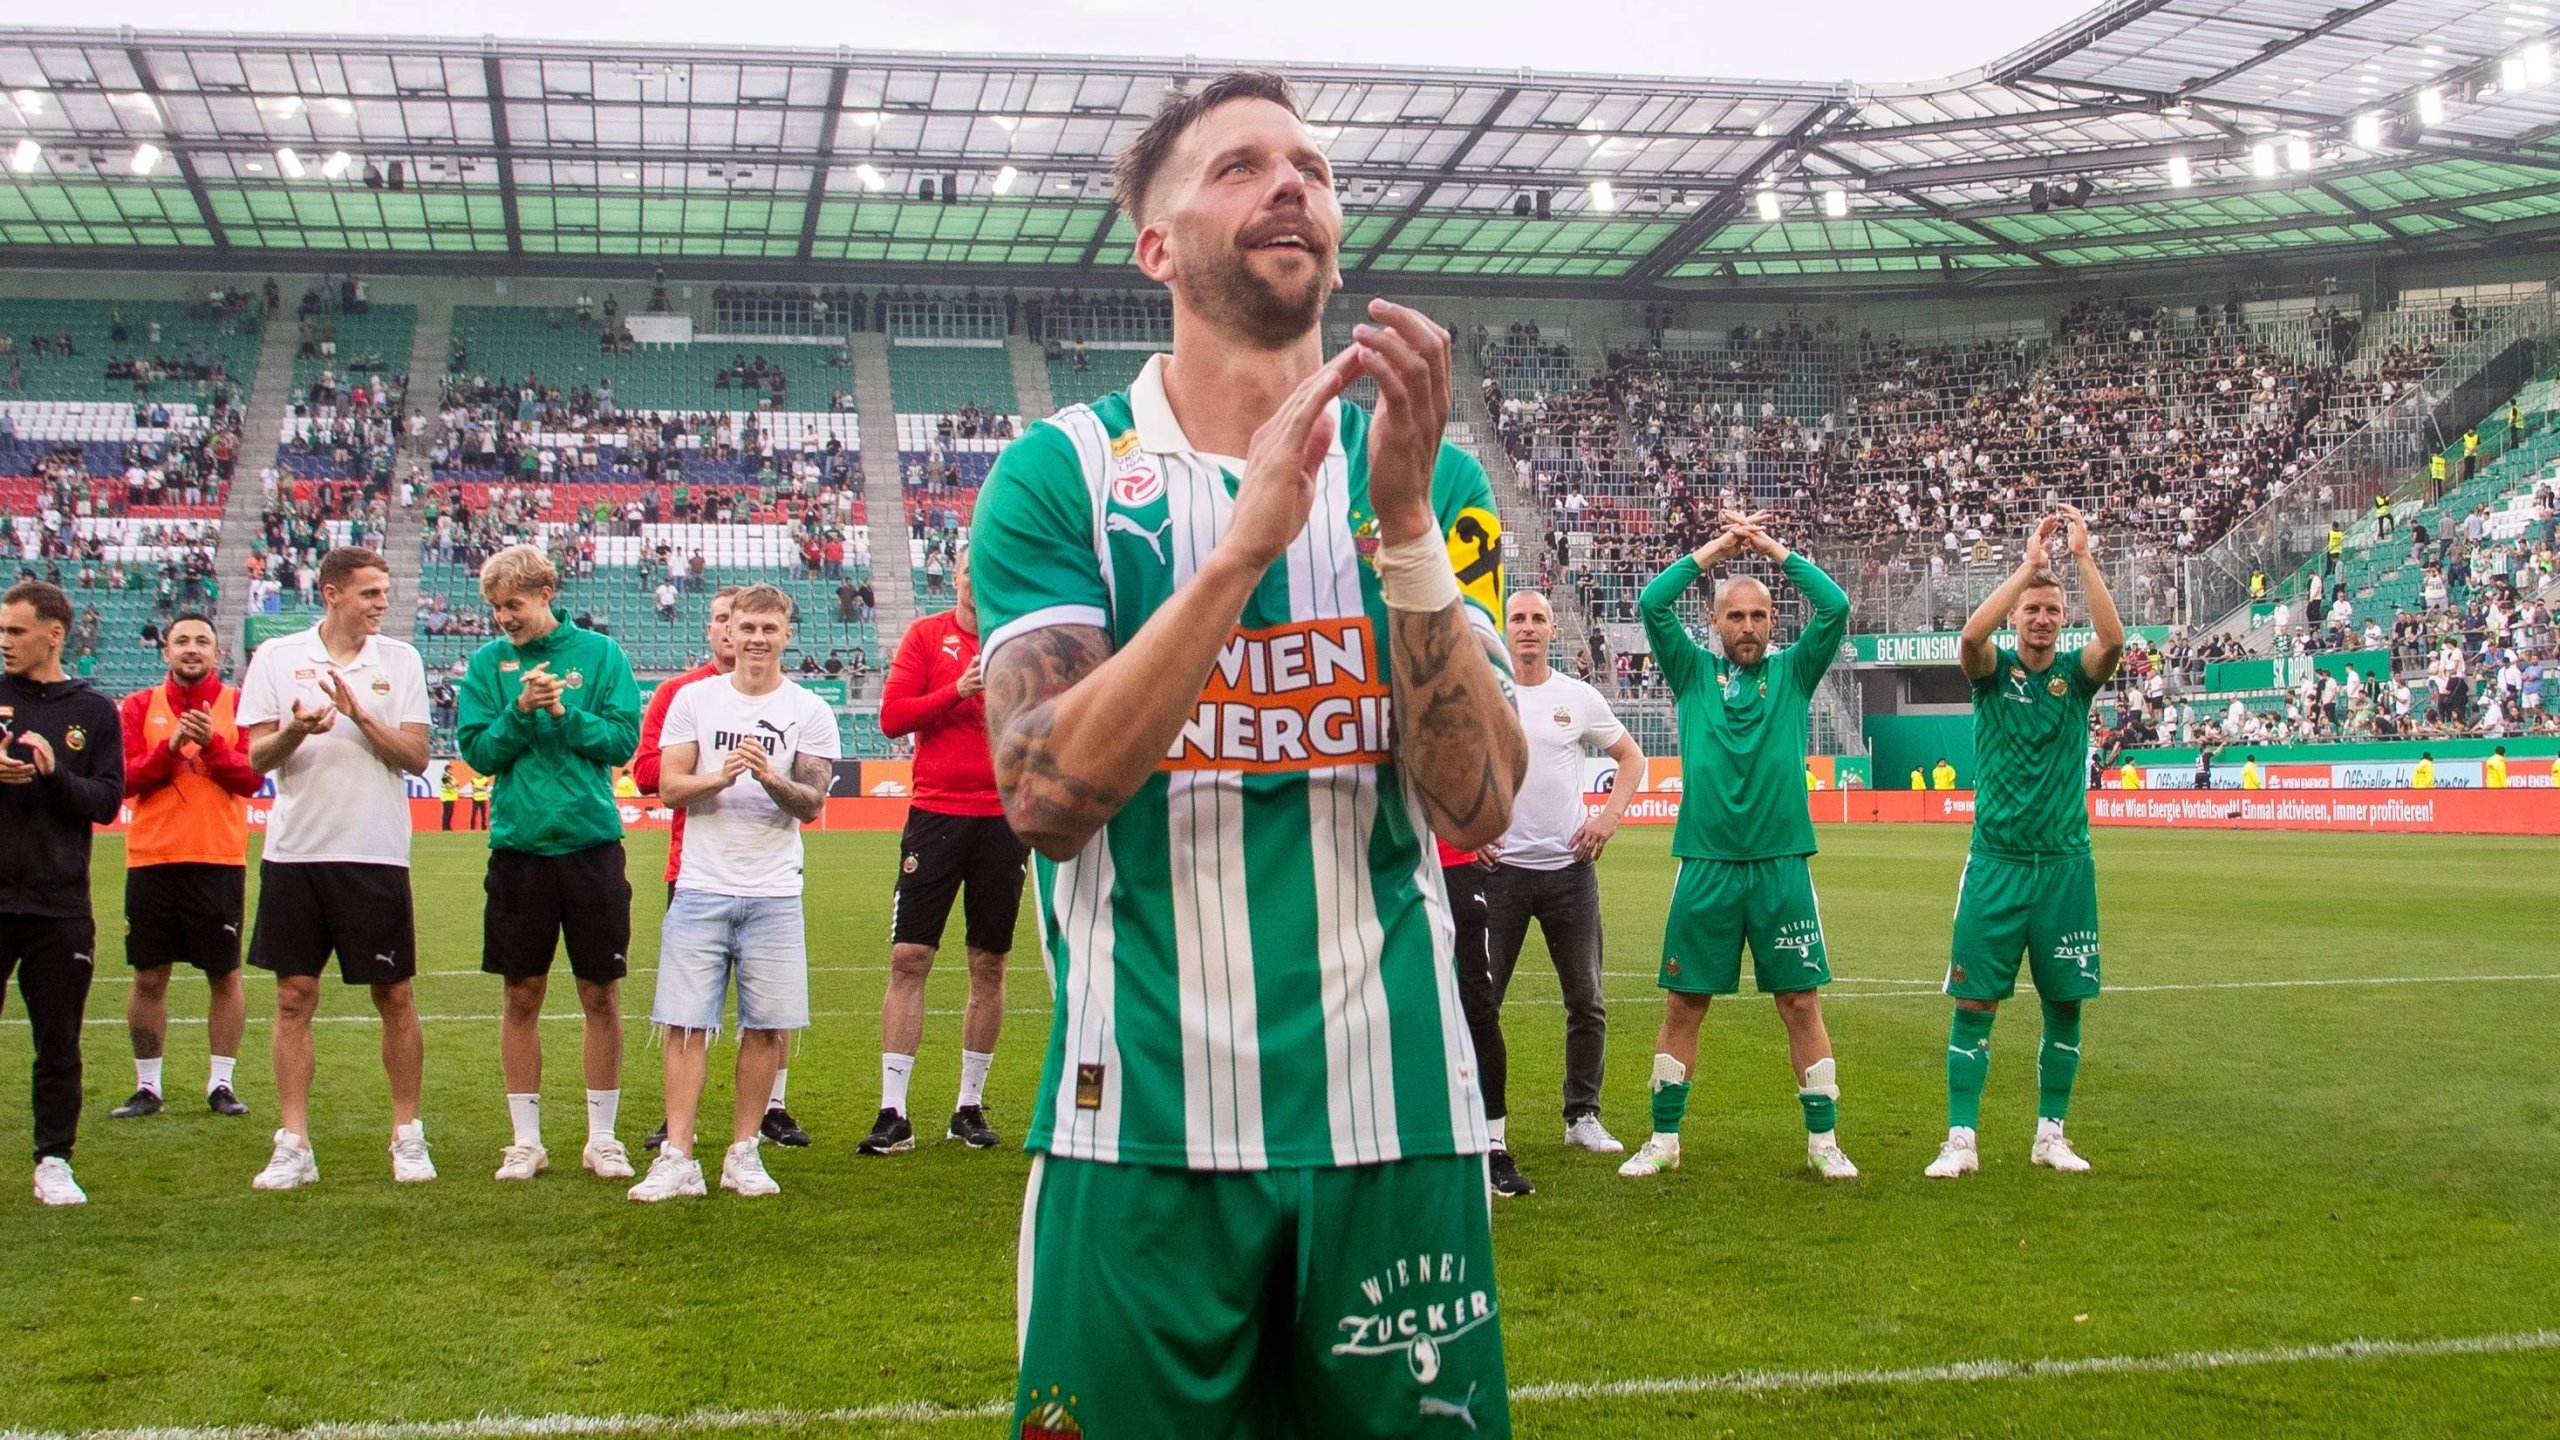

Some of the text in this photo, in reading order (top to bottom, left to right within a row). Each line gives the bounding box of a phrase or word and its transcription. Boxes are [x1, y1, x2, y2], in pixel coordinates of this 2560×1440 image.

[1877, 635, 1962, 661] GEMEINSAM
[2273, 657, 2285, 688] SK
[1166, 696, 1392, 763] NERGI
[2095, 798, 2434, 826] Mit der Wien Energie Vorteilswelt! Einmal aktivieren, immer profitieren!
[1332, 1290, 1497, 1355] ZUCKER
